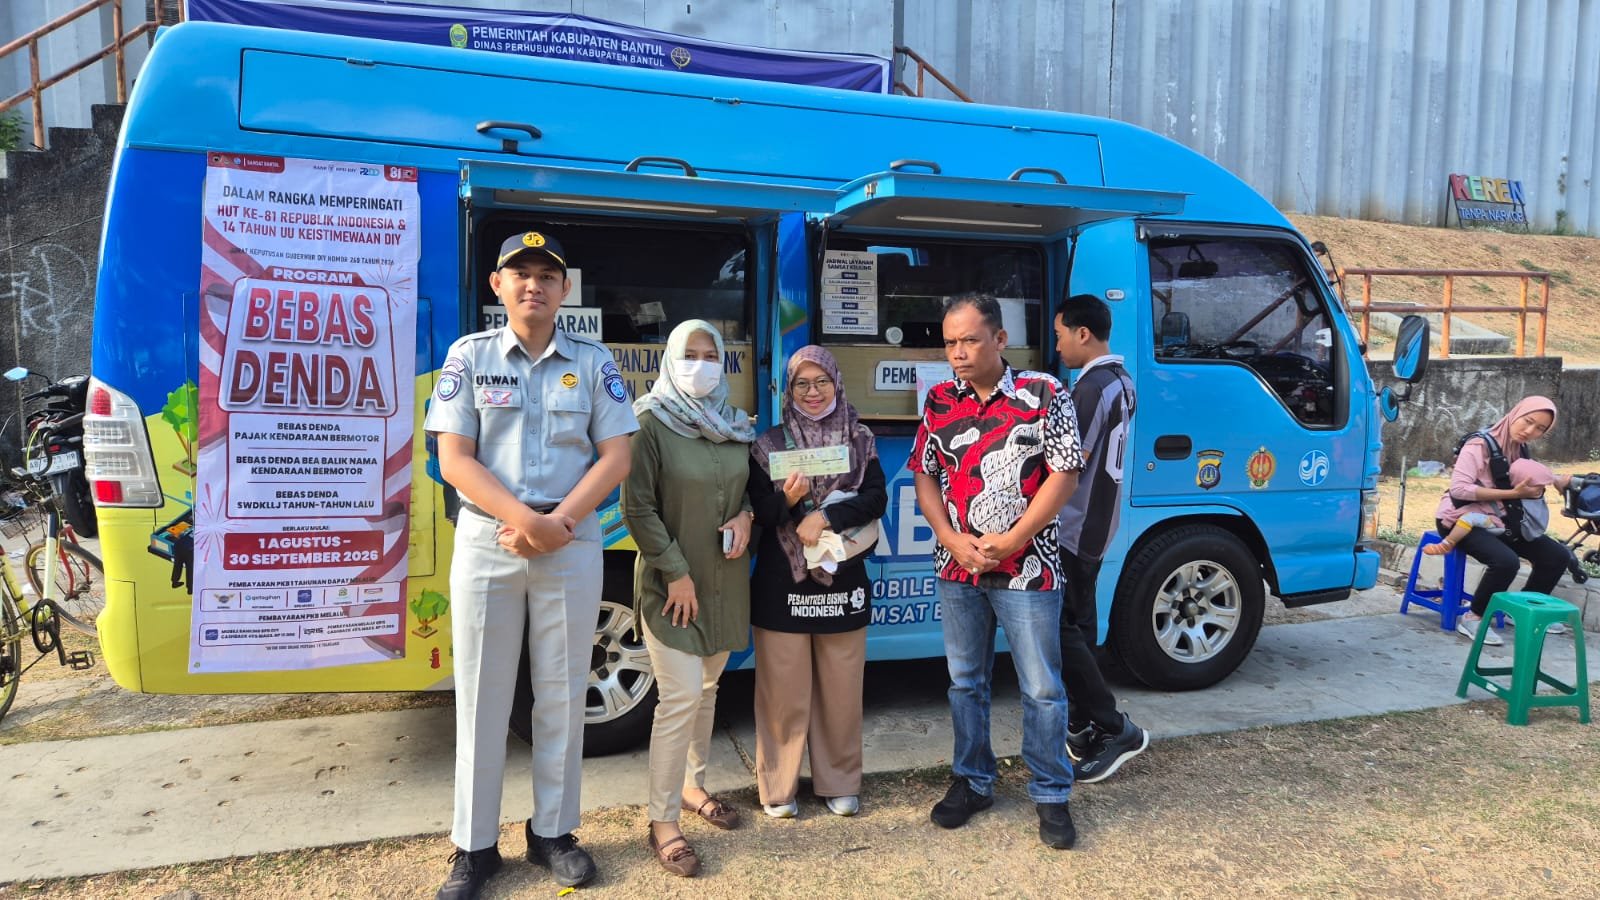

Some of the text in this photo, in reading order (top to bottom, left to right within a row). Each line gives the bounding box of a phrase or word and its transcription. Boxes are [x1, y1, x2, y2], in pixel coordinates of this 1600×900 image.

[473, 27, 665, 56] PEMERINTAH KABUPATEN BANTUL
[474, 41, 664, 67] DINAS PERHUBUNGAN KABUPATEN BANTUL
[1450, 173, 1525, 206] KEREN
[223, 185, 402, 211] DALAM RANGKA MEMPERINGATI
[217, 205, 406, 230] HUT KE-81 REPUBLIK INDONESIA &
[1460, 207, 1487, 220] TANPA
[222, 221, 401, 246] 14 TAHUN UU KEISTIMEWAAN DIY
[250, 248, 284, 258] KEPUTUSAN
[286, 251, 315, 261] GUBERNUR
[327, 255, 348, 263] NOMOR
[273, 268, 353, 284] PROGRAM
[243, 287, 377, 347] BEBAS
[228, 350, 388, 410] DENDA
[476, 375, 518, 386] ULWAN
[277, 422, 340, 431] BEBAS DENDA
[235, 432, 380, 442] PAJAK KENDARAAN BERMOTOR
[236, 456, 377, 465] BEBAS DENDA BEA BALIK NAMA
[251, 467, 363, 475] KENDARAAN BERMOTOR
[276, 491, 305, 499] BEBAS
[237, 500, 374, 509] SWDKLLJ TAHUN-TAHUN LALU
[259, 538, 265, 549] 1
[268, 536, 341, 549] AGUSTUS
[230, 550, 379, 565] 30 SEPTEMBER 2026
[294, 579, 327, 587] TAHUNAN
[873, 577, 934, 598] OBILE
[787, 592, 849, 606] PESANTREN BISNIS
[791, 605, 845, 617] INDONESIA
[871, 603, 928, 624] MSAT
